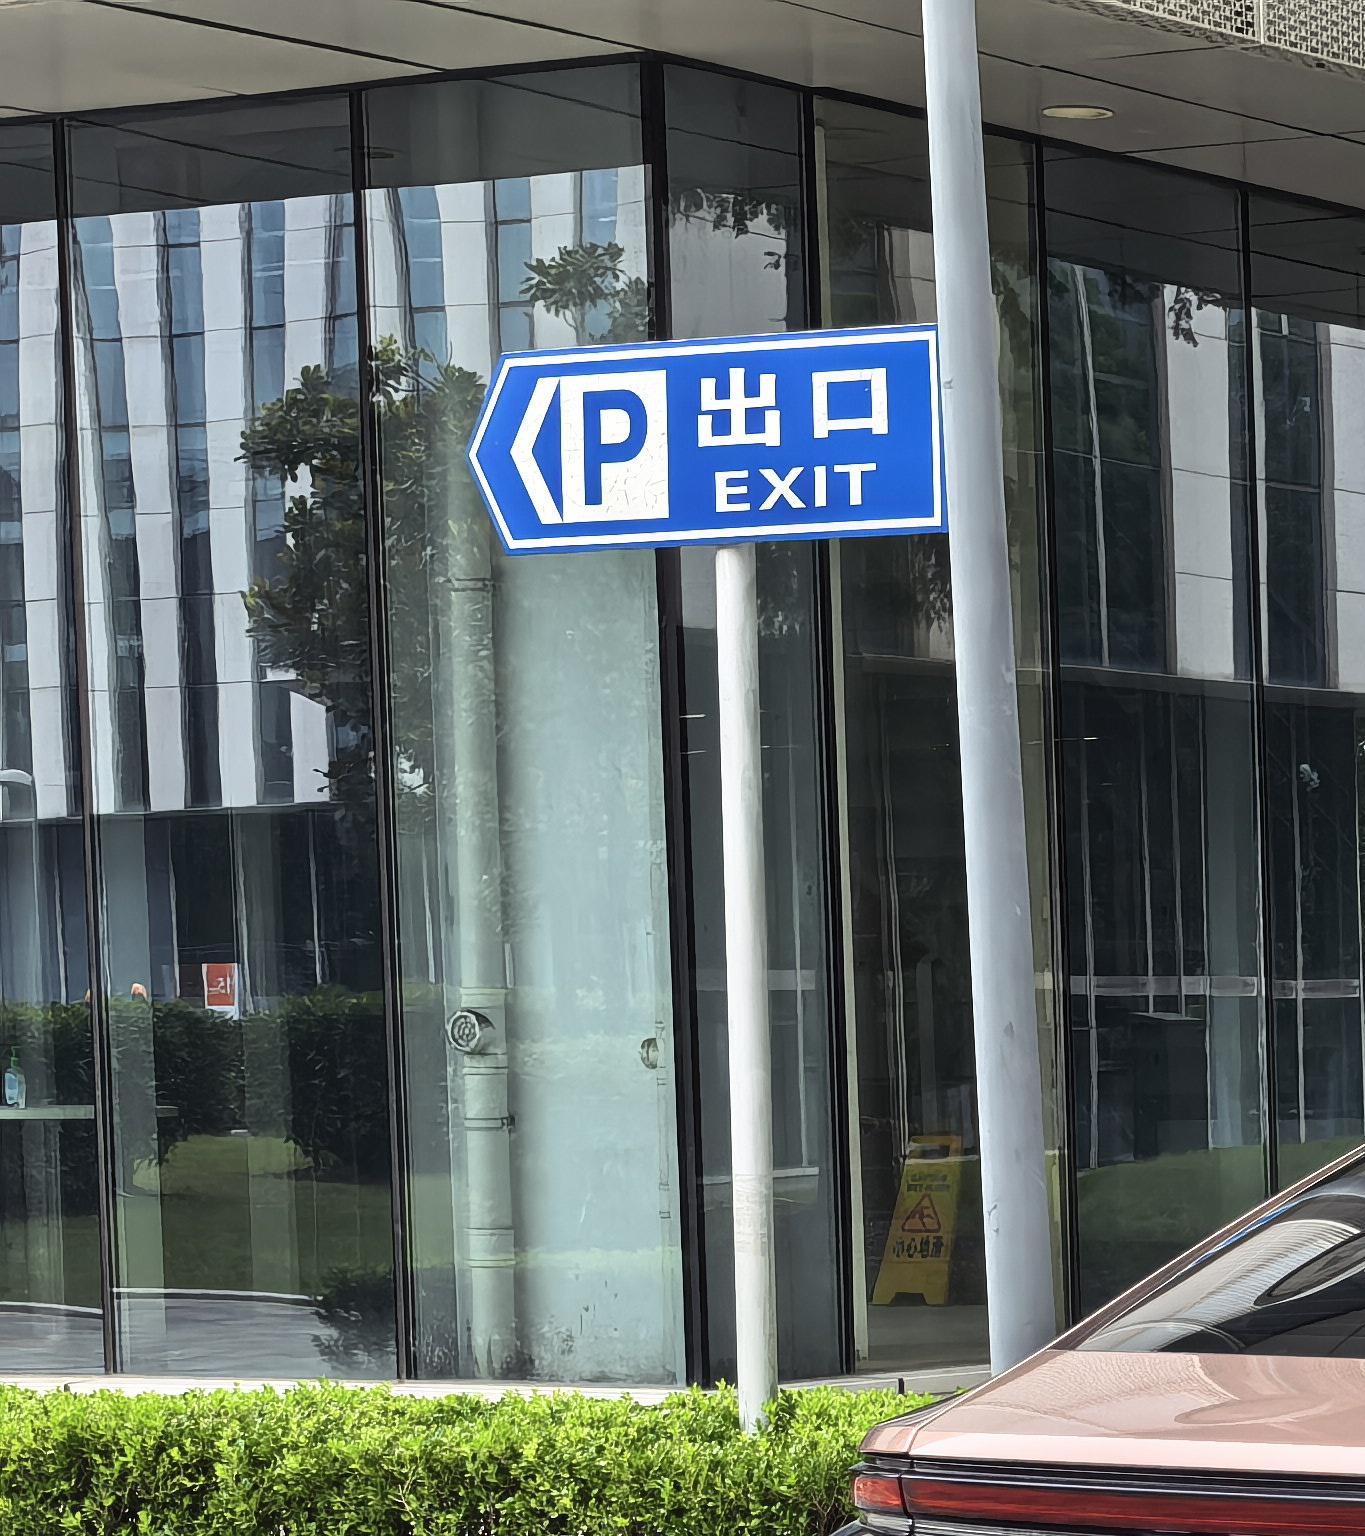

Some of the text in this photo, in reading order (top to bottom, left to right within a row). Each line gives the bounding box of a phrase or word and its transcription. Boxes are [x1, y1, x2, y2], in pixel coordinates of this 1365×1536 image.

[582, 388, 649, 506] P
[697, 366, 889, 448] 出口
[714, 462, 878, 513] EXIT
